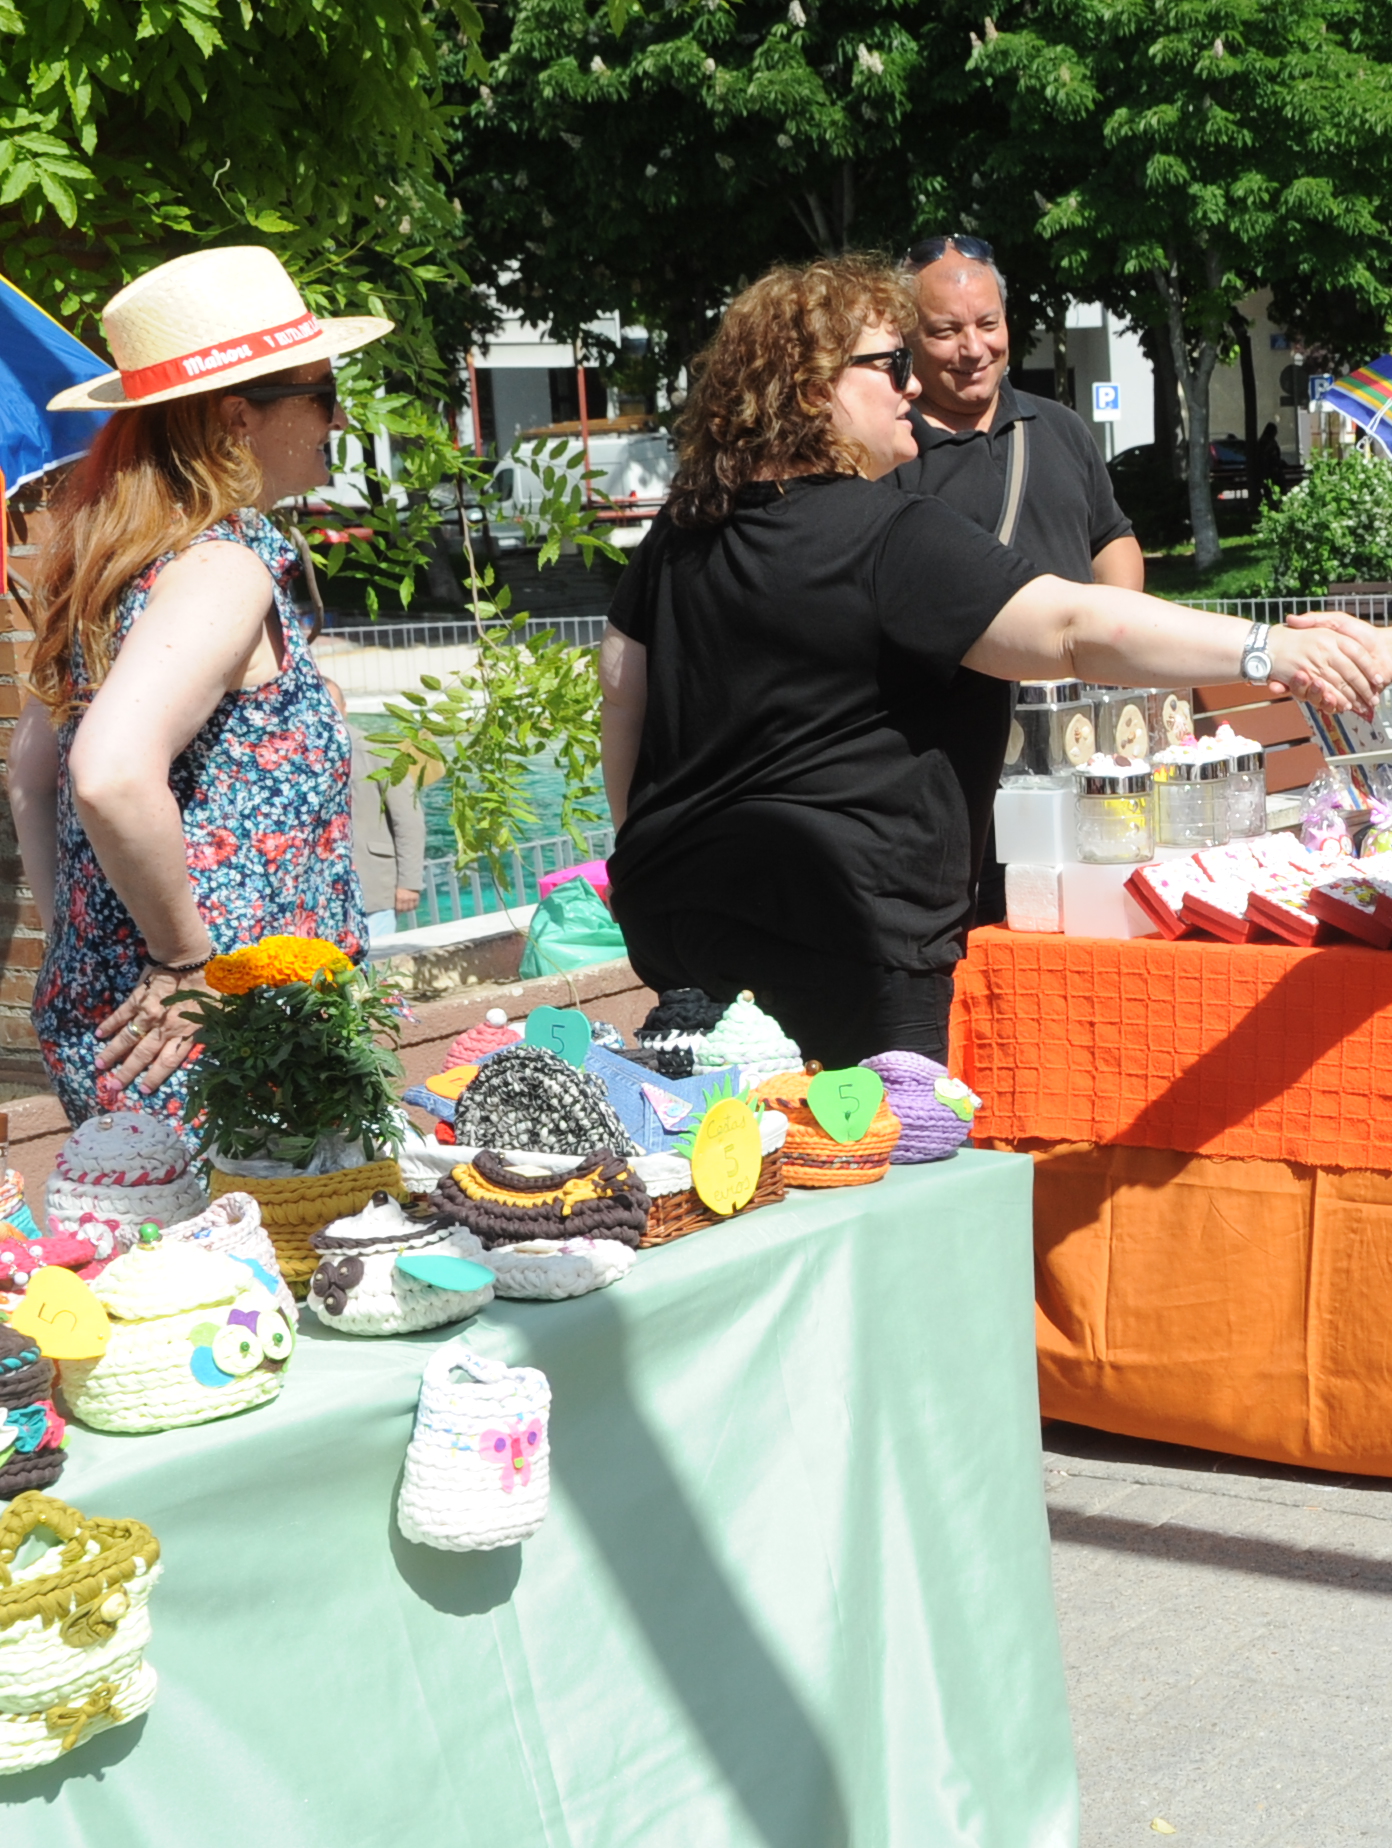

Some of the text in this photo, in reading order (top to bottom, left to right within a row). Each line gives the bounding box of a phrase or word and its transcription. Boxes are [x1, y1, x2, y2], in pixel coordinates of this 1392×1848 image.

[182, 343, 253, 376] Mahou
[1098, 386, 1116, 409] P
[551, 1024, 566, 1055] 5
[838, 1083, 860, 1114] 5
[723, 1143, 740, 1178] 5
[714, 1175, 751, 1202] euros
[37, 1302, 77, 1333] 5
